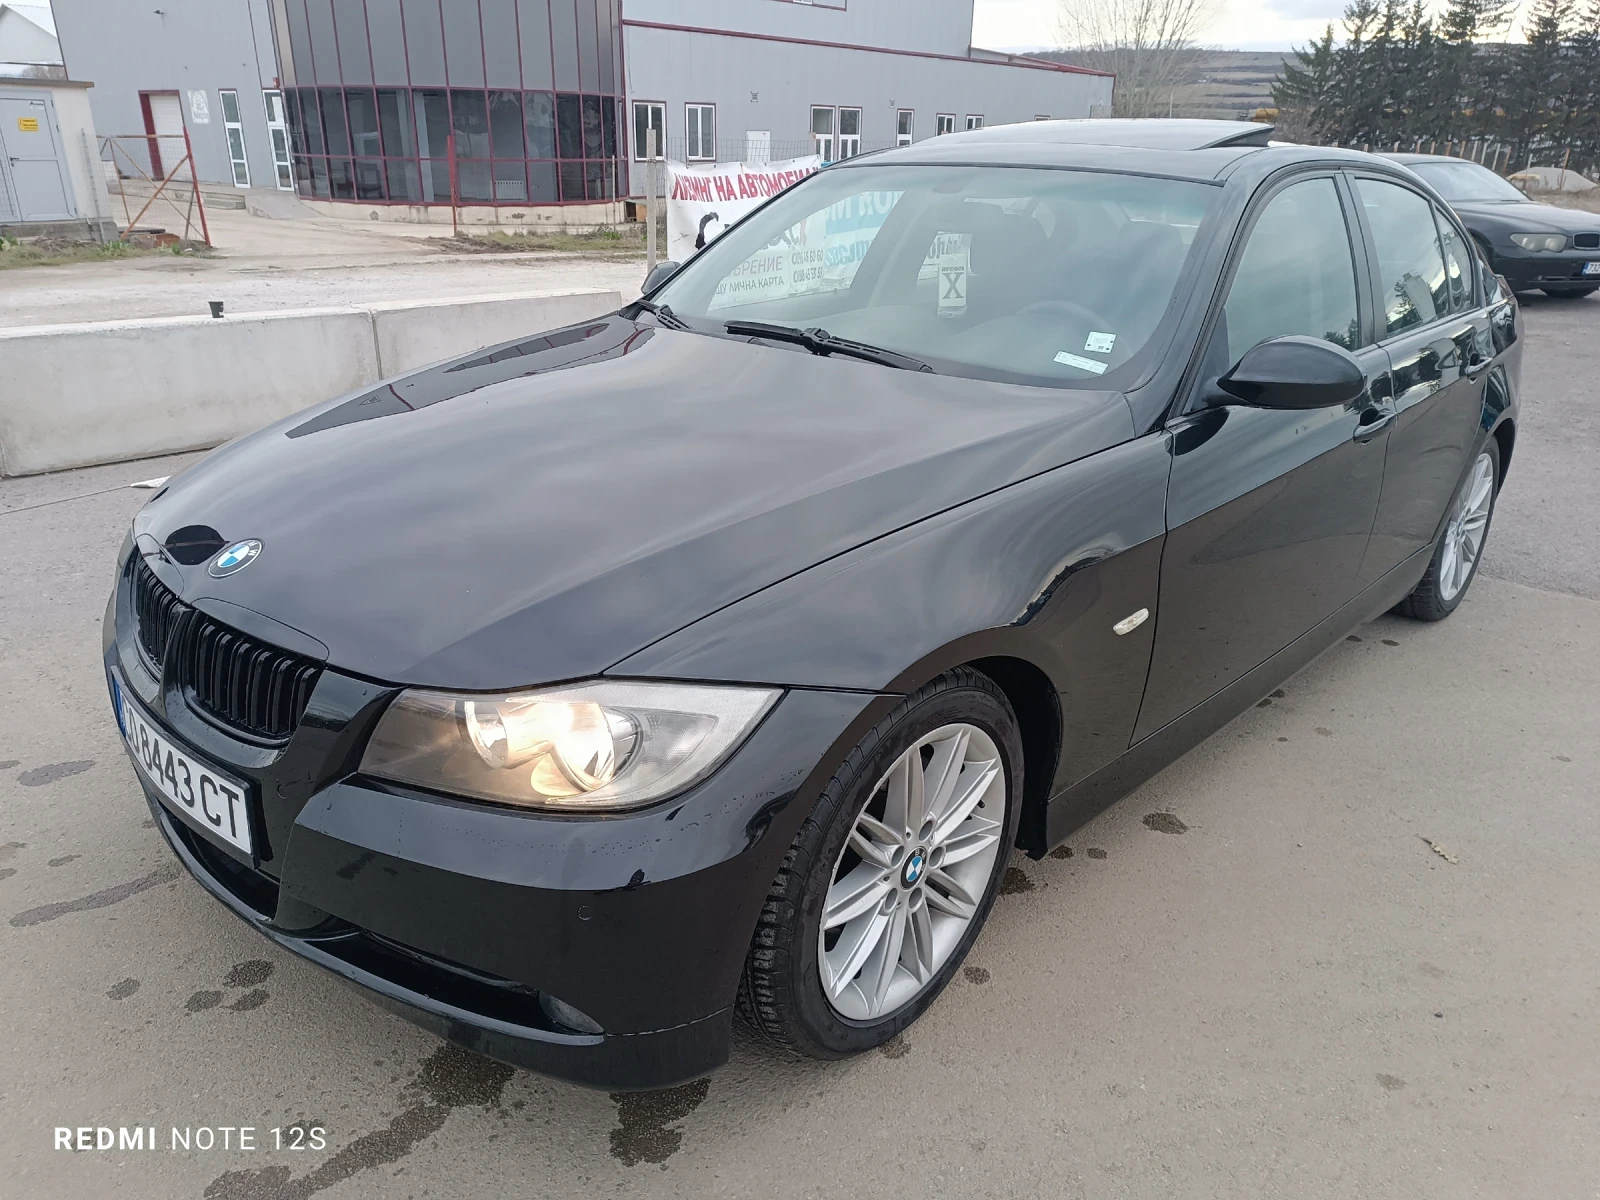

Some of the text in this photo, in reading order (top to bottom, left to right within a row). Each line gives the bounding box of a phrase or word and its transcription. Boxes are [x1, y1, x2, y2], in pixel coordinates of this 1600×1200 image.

[713, 175, 737, 202] НА
[728, 279, 757, 293] ЛИЧНА
[758, 276, 785, 289] КАРТА
[941, 272, 965, 299] X
[200, 774, 240, 839] CT
